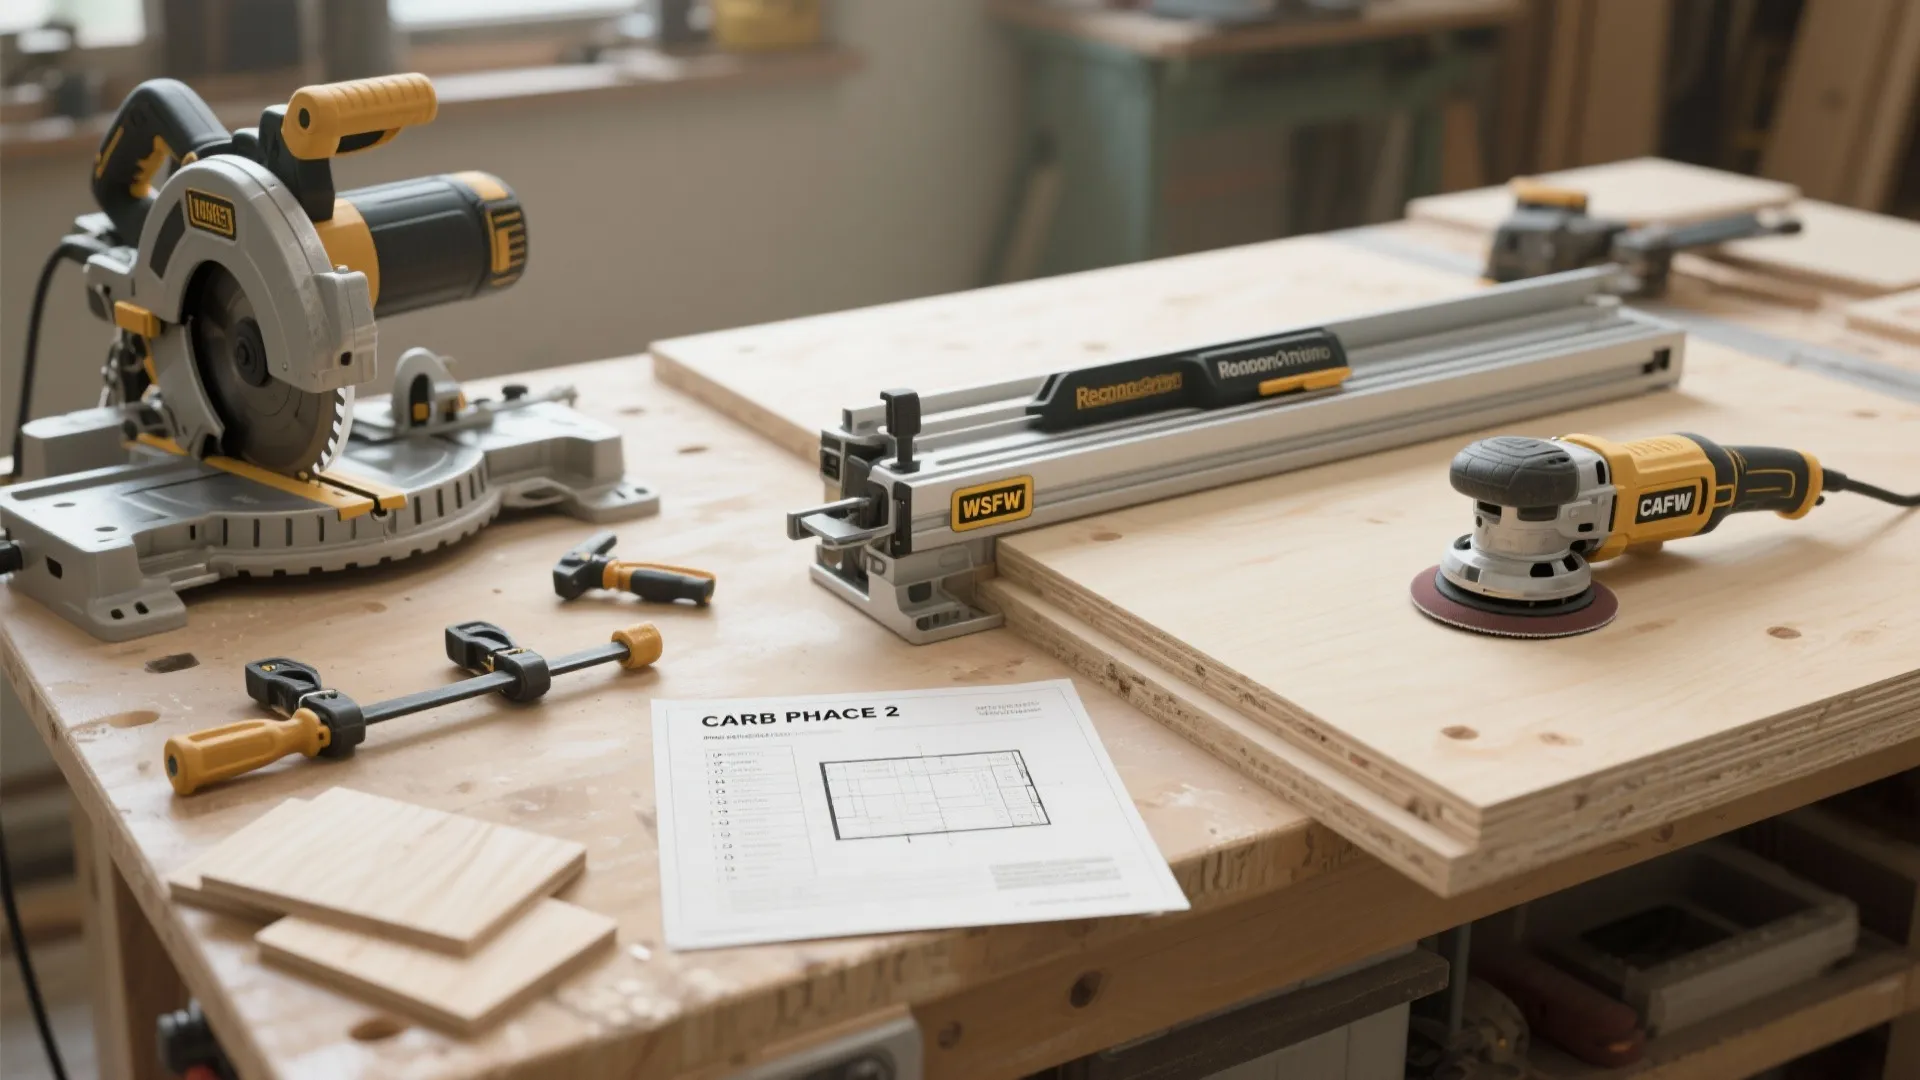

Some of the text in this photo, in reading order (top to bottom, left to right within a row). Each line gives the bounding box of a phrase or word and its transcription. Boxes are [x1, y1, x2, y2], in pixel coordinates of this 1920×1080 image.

[963, 490, 1022, 518] WSFW
[1640, 492, 1692, 517] CAFW
[702, 706, 900, 727] CARB PHACE 2
